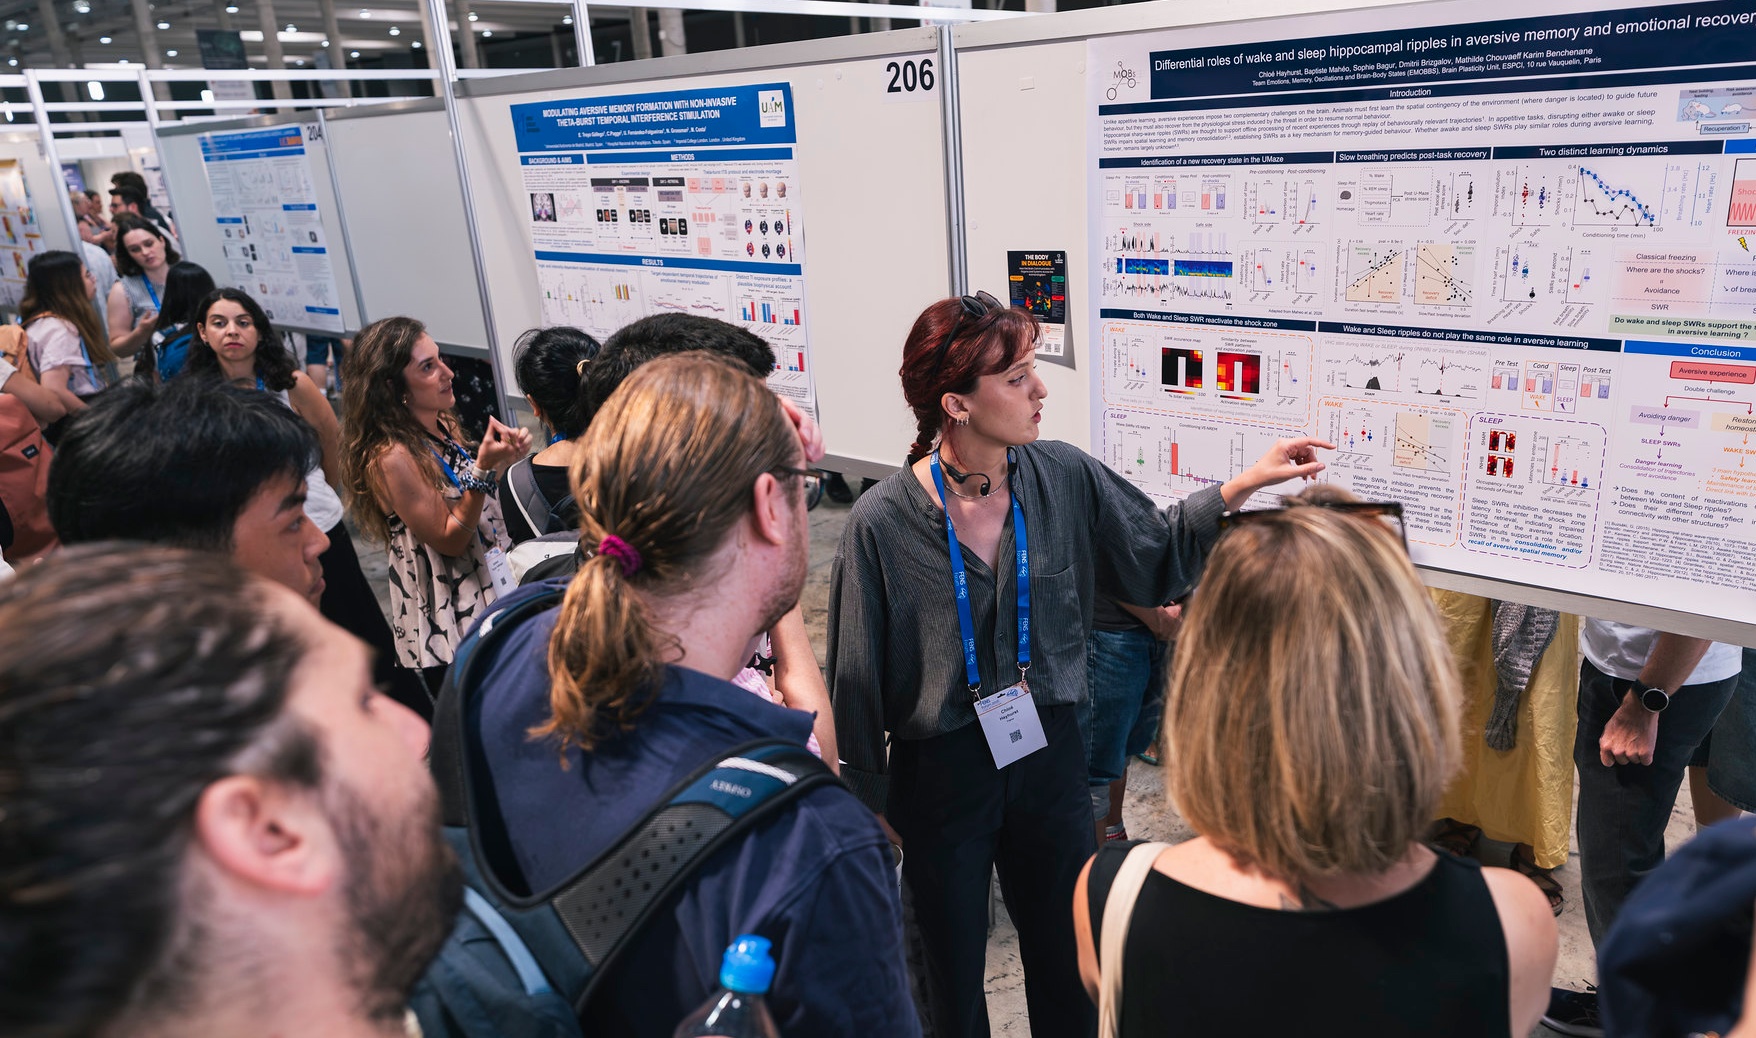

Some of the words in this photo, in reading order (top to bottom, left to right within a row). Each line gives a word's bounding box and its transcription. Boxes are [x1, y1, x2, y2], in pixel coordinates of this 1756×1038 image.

[1155, 56, 1205, 71] Differential
[1207, 55, 1231, 67] roles
[1233, 53, 1244, 65] of
[1245, 52, 1273, 64] wake
[1275, 49, 1295, 62] and
[1298, 48, 1327, 61] sleep
[1330, 40, 1403, 59] hippocampal
[1407, 37, 1448, 53] ripples
[1451, 35, 1462, 47] in
[1466, 31, 1520, 46] aversive
[1524, 27, 1580, 41] memory
[1584, 21, 1612, 37] and
[1616, 14, 1691, 34] emotional
[1695, 12, 1756, 28] recover
[1304, 68, 1328, 76] Baptiste
[1353, 64, 1375, 72] Sophie
[1399, 60, 1420, 68] Dmitrii
[1455, 55, 1484, 64] Mathilde
[1523, 51, 1545, 59] Karim
[1546, 48, 1593, 58] Benchenane
[1356, 72, 1387, 80] Brain-Body
[1584, 56, 1602, 64] Paris
[886, 59, 935, 93] 206
[1390, 88, 1432, 97] Introduction
[543, 108, 579, 117] MODULATING
[580, 105, 608, 115] AVERSIVE
[609, 104, 635, 113] MEMORY
[636, 101, 673, 112] FORMATION
[674, 100, 689, 109] WITH
[690, 96, 737, 108] NON-INVASIVE
[761, 101, 783, 114] UAM
[557, 117, 596, 126] THETA-BURST
[596, 115, 630, 125] TEMPORAL
[631, 112, 678, 123] INTERFERENCE
[679, 110, 720, 120] STIMULATION
[1539, 148, 1556, 156] Two
[1558, 148, 1588, 156] distinct
[1590, 146, 1624, 156] learning
[1626, 145, 1668, 156] dynamics
[1200, 158, 1228, 166] recovery
[1357, 153, 1389, 162] breathing
[1390, 152, 1418, 161] predicts
[1419, 151, 1452, 160] post-task
[1453, 151, 1488, 160] recovery
[1668, 254, 1697, 262] freezing
[1173, 314, 1189, 322] Sleep
[1662, 319, 1682, 328] sleep
[1683, 320, 1706, 328] SWRs
[1343, 325, 1362, 333] Wake
[1377, 327, 1397, 336] Sleep
[1398, 329, 1421, 337] ripples
[1446, 332, 1461, 340] play
[1523, 338, 1555, 346] aversive
[1557, 339, 1589, 350] learning
[1710, 330, 1741, 340] learning
[1691, 347, 1741, 358] Conclusion
[1560, 364, 1577, 373] Sleep
[1678, 367, 1708, 375] Aversive
[1706, 388, 1736, 396] challenge
[1479, 416, 1503, 424] SLEEP
[1638, 412, 1667, 421] Avoiding
[1667, 415, 1692, 423] danger
[1515, 540, 1557, 550] consolidation
[1493, 543, 1518, 551] aversive
[1541, 551, 1567, 560] memory
[958, 571, 966, 586] FENS
